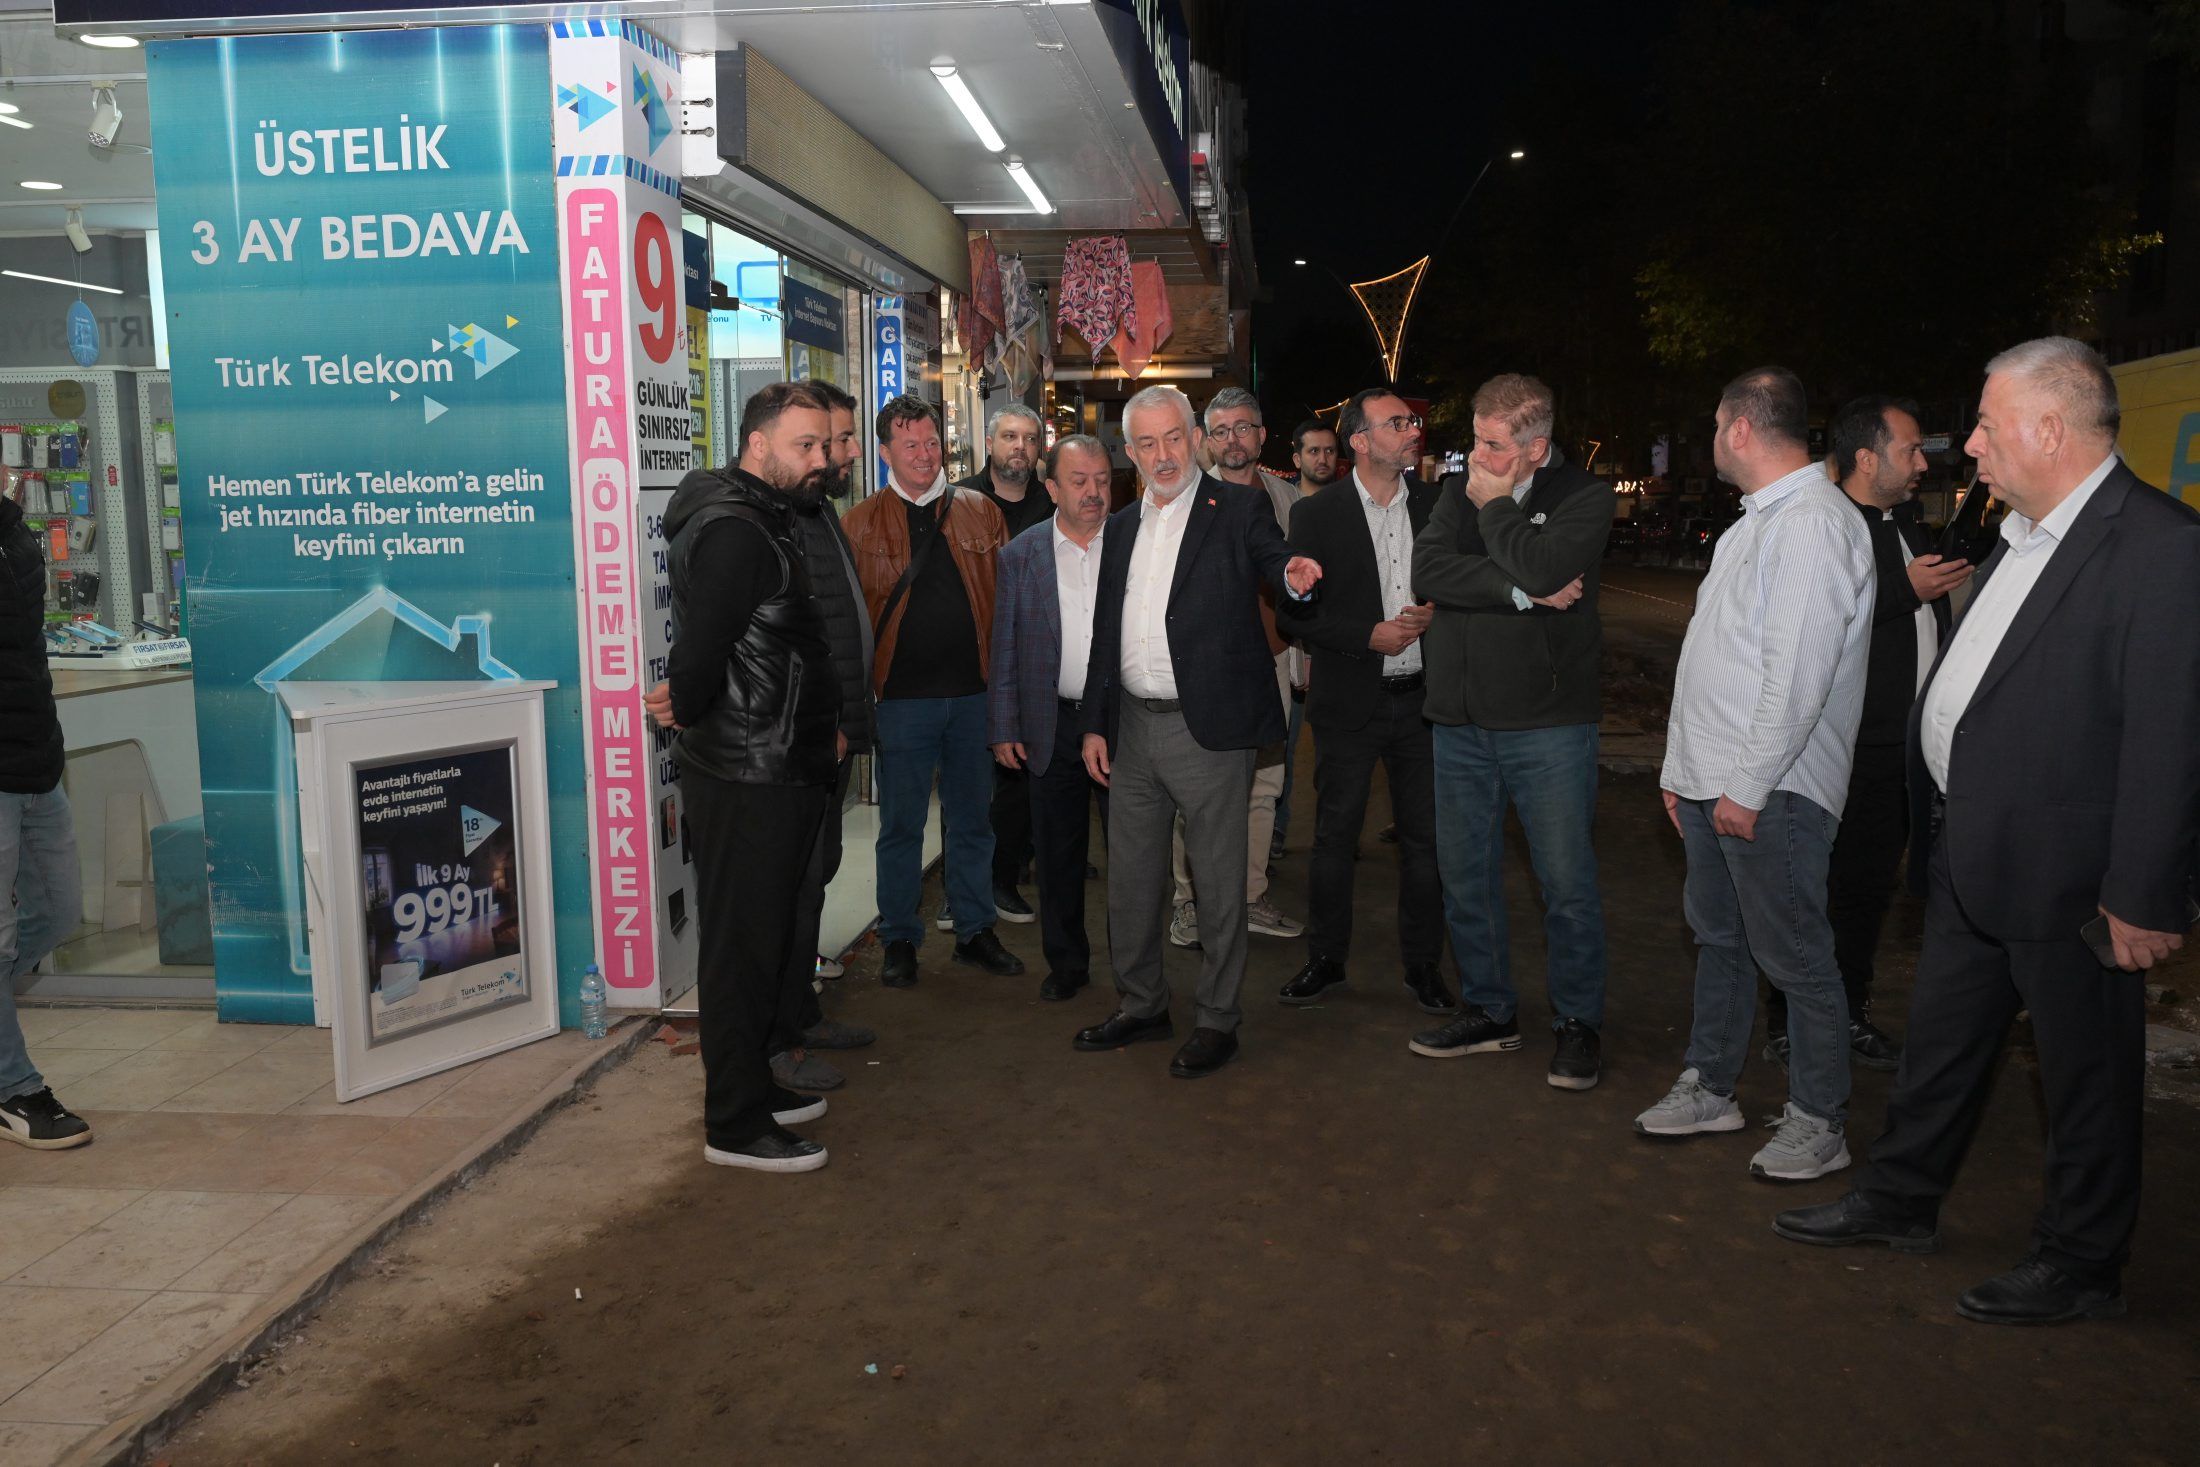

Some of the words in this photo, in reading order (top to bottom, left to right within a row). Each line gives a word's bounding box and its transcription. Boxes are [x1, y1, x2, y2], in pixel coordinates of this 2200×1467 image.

[254, 113, 450, 177] ÜSTELİK
[191, 220, 219, 265] 3
[238, 217, 302, 263] AY
[320, 210, 530, 260] BEDAVA
[579, 203, 616, 449] FATURA
[760, 314, 773, 323] TV
[214, 355, 292, 388] Türk
[302, 352, 454, 385] Telekom
[637, 376, 688, 411] GÜNLÜK
[638, 414, 691, 441] SINIRSIZ
[640, 444, 691, 471] İNTERNET
[208, 475, 291, 497] Hemen
[296, 472, 352, 496] Türk
[486, 468, 544, 497] gelin
[220, 504, 252, 532] jet
[258, 503, 347, 527] hızında
[352, 502, 411, 526] fiber
[416, 499, 535, 524] internetin
[293, 533, 376, 561] keyfini
[382, 532, 465, 561] çıkarın
[592, 473, 627, 676] ÖDEME
[133, 643, 157, 654] FIRSAT
[362, 775, 411, 792] Avantajlı
[412, 767, 462, 785] fiyatlarla
[362, 792, 389, 807] evde
[391, 785, 444, 802] internetin
[363, 806, 401, 823] keyfini
[403, 797, 447, 818] yaşayın!
[464, 818, 480, 832] 18
[603, 707, 640, 978] MERKEZİ
[440, 864, 452, 882] 9
[454, 864, 470, 882] Ay
[393, 882, 473, 944] 999
[474, 886, 499, 917] TL
[477, 976, 505, 992] Telekom
